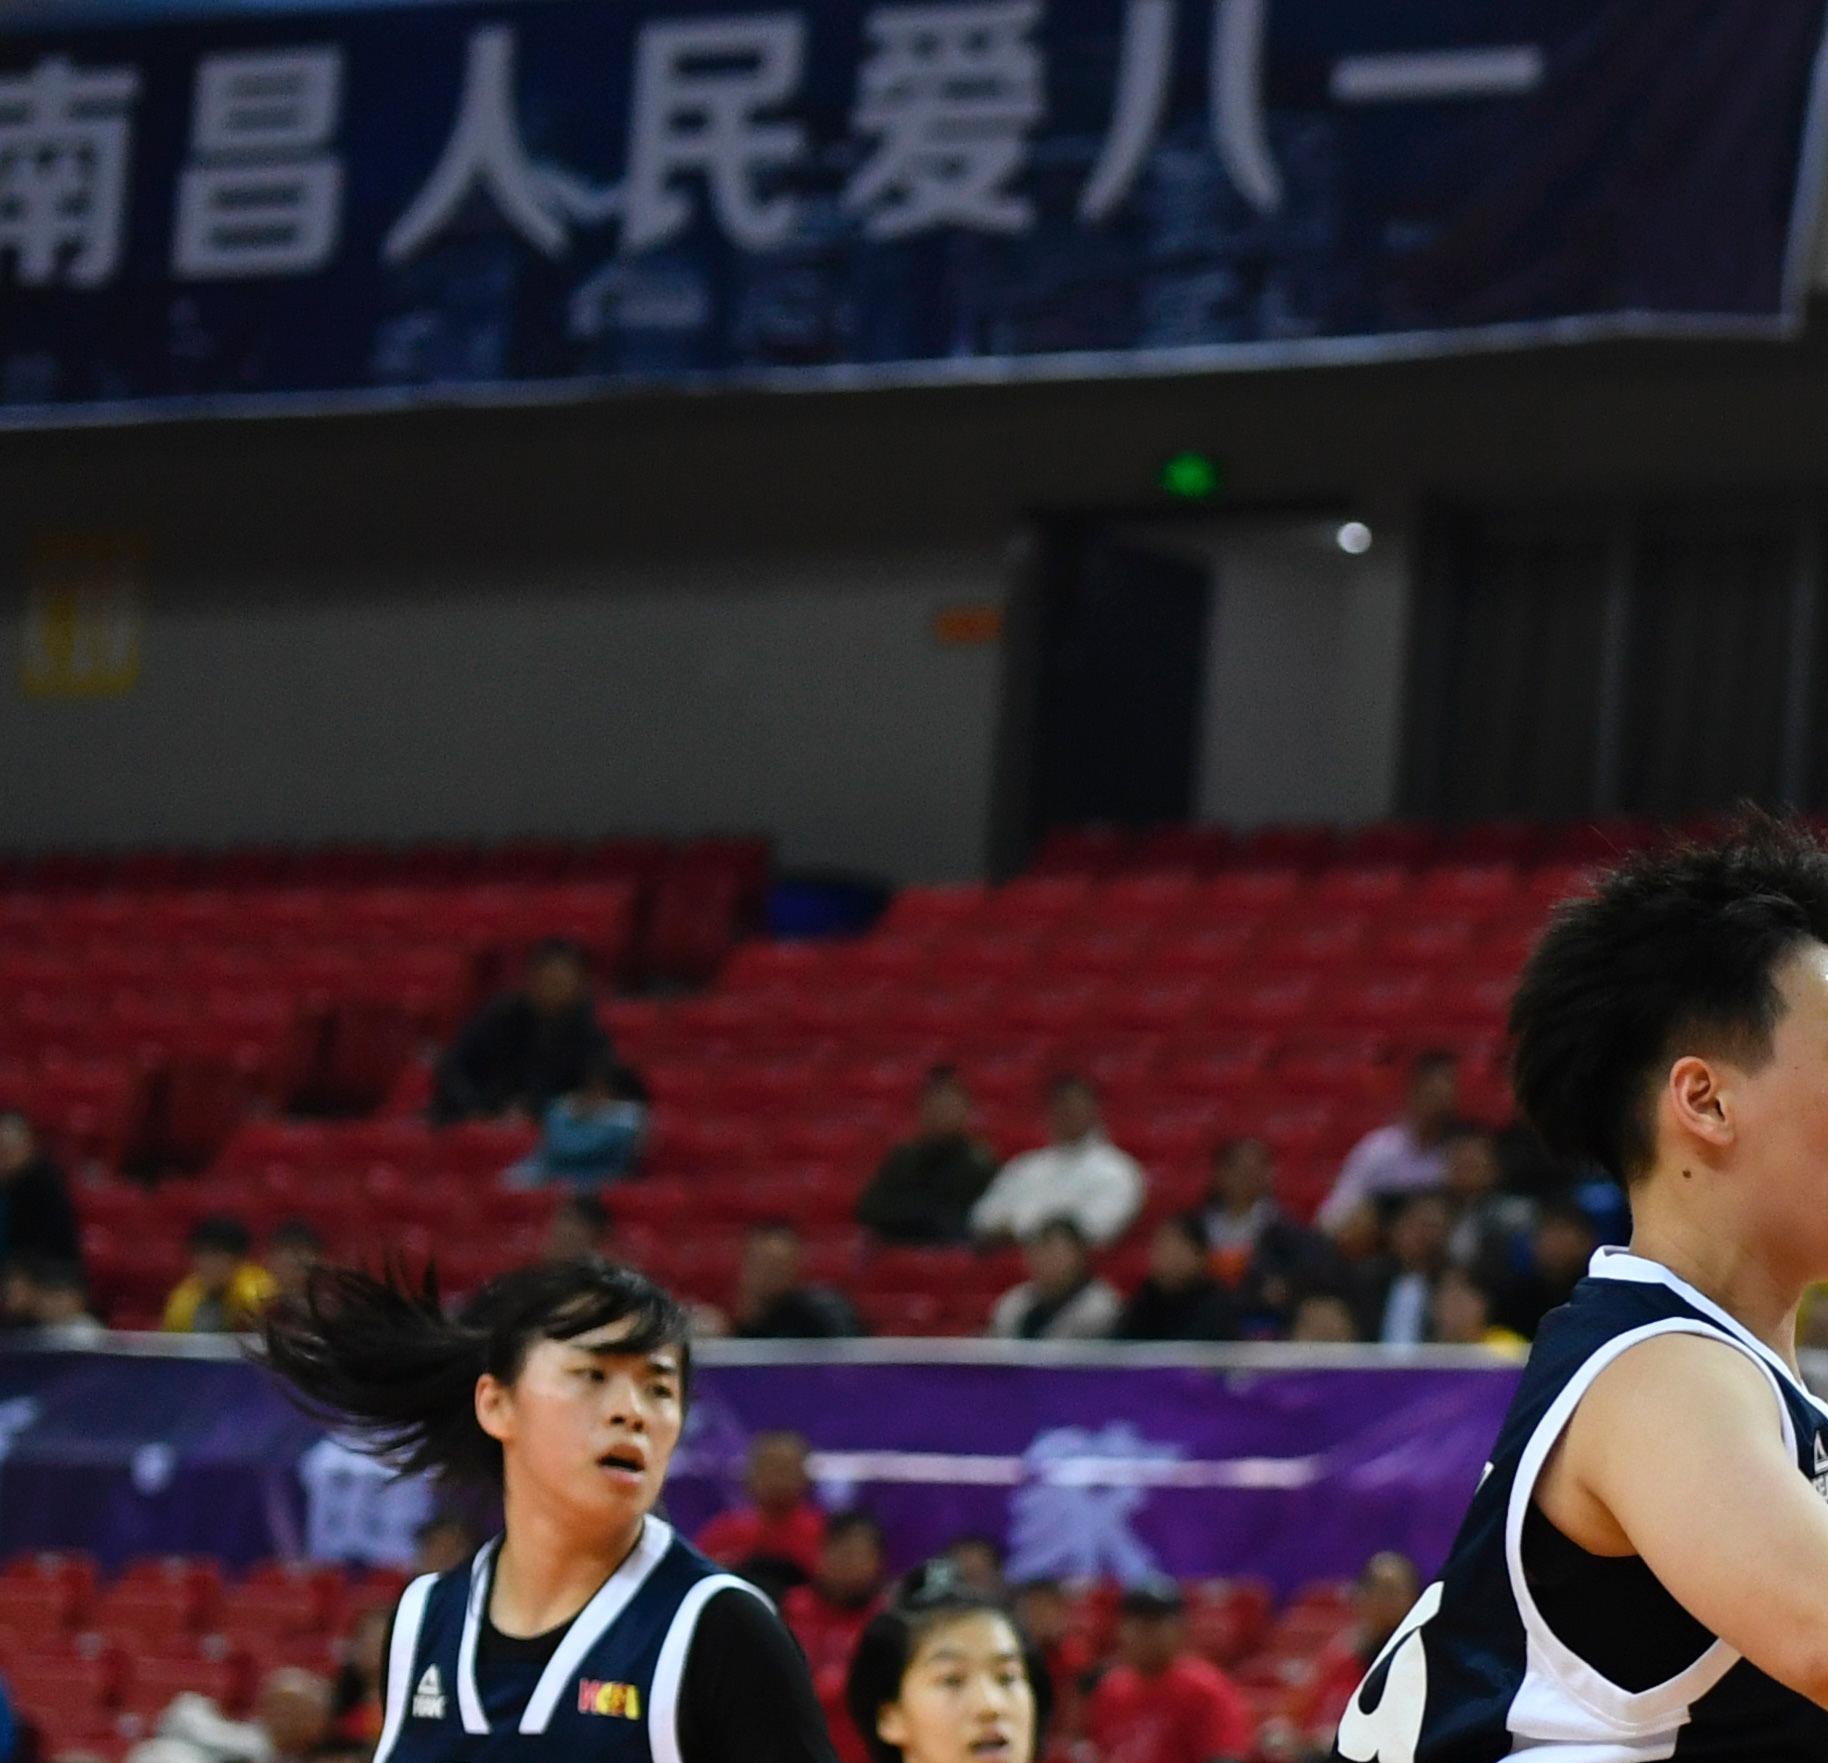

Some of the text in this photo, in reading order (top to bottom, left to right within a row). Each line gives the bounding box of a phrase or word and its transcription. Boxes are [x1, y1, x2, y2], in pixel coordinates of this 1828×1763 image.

[0, 0, 1542, 285] 南昌人民爱八一
